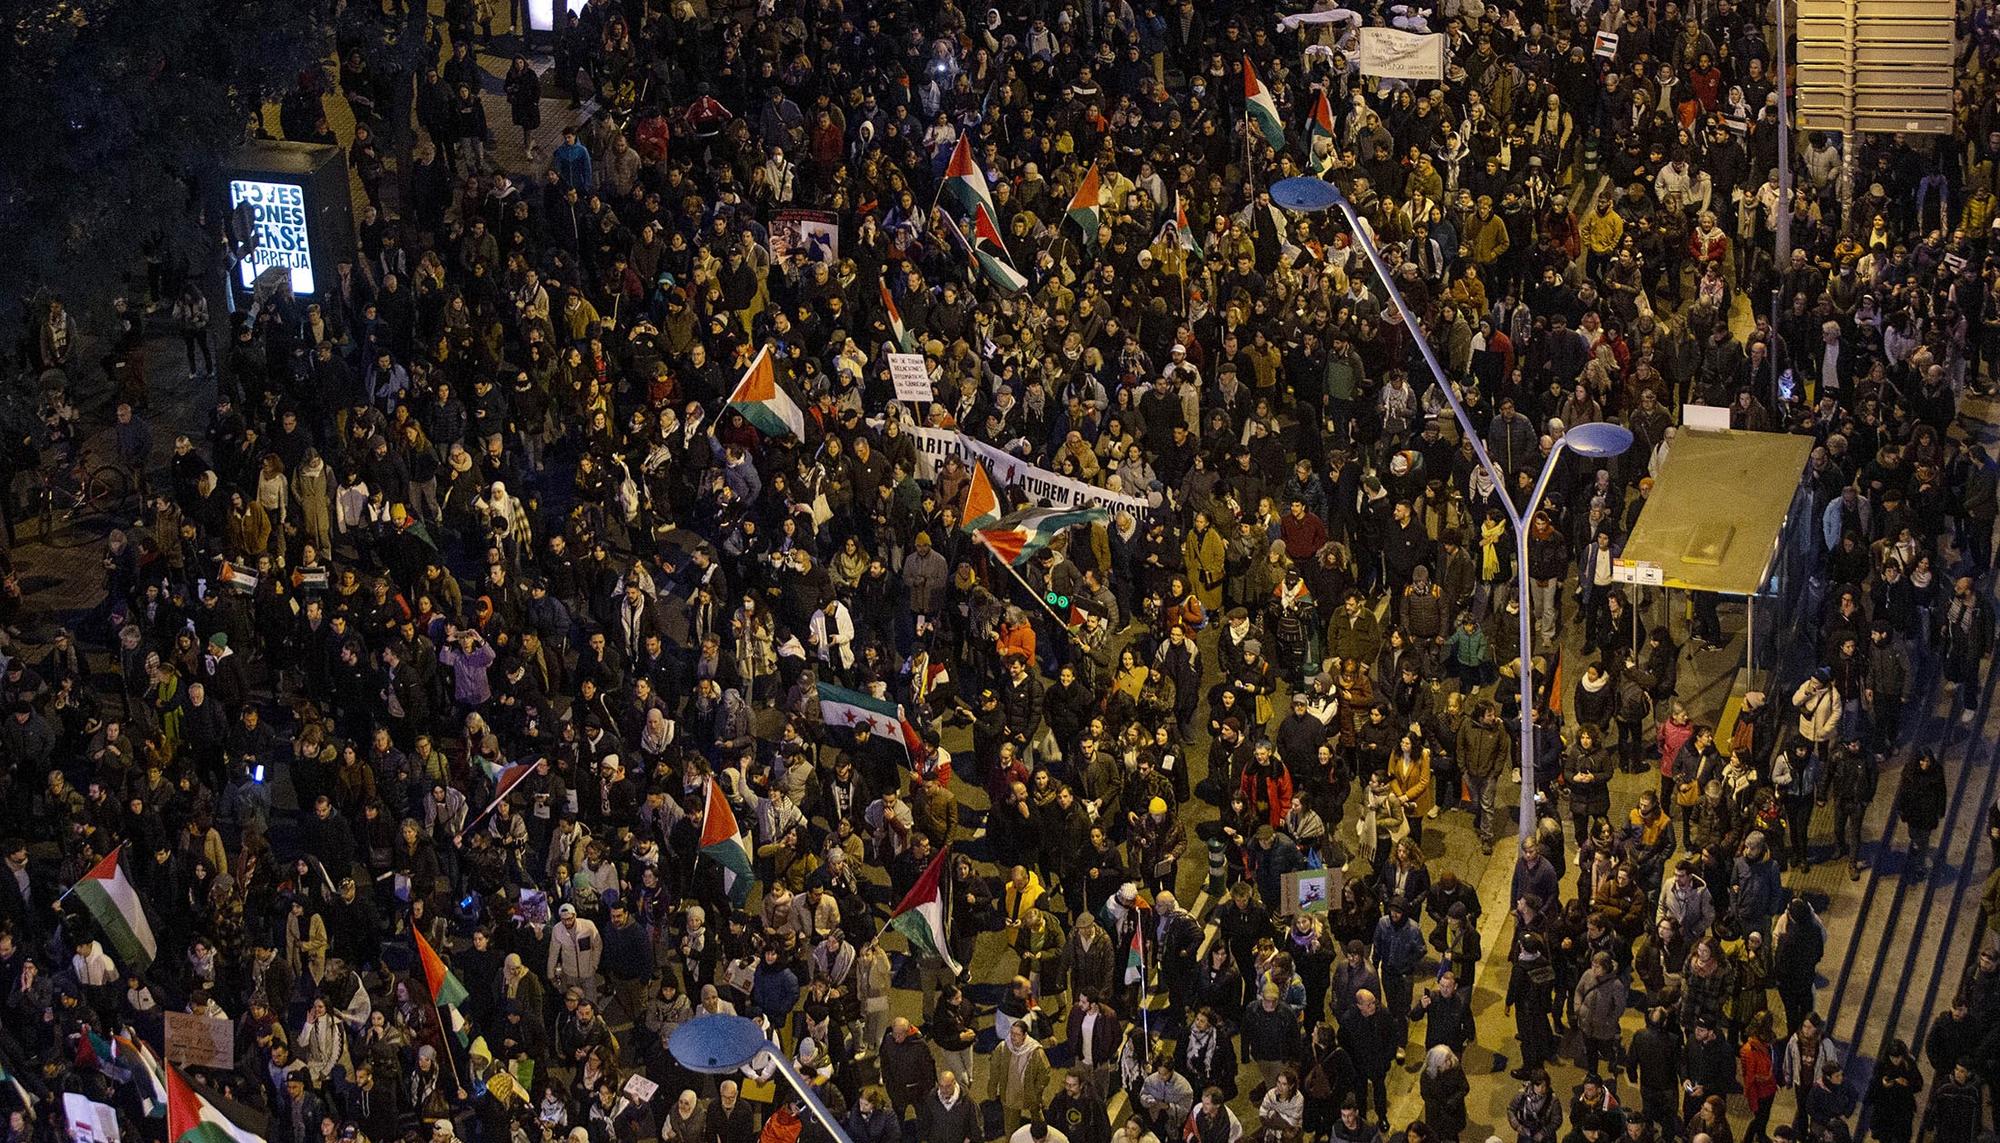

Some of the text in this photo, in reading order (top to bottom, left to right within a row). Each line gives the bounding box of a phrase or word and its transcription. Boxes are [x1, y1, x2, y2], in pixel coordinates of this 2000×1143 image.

[251, 203, 304, 226] ONES
[254, 224, 307, 252] ENSE
[1019, 474, 1070, 504] ATUREM
